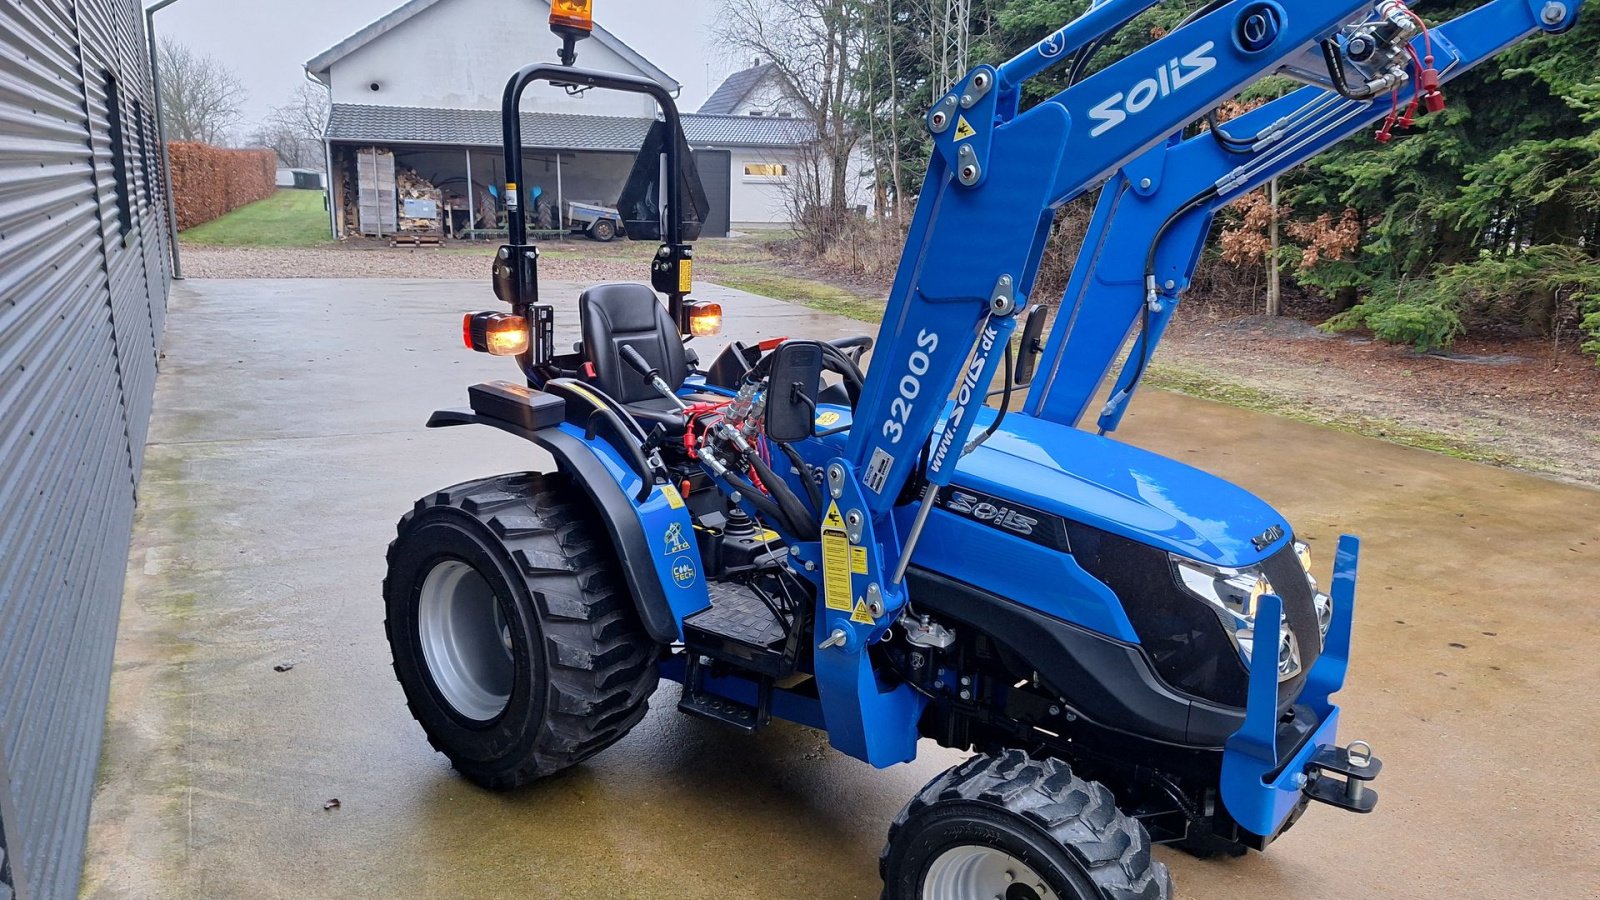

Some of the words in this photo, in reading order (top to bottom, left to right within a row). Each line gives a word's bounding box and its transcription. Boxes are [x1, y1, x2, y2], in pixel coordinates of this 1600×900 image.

[883, 328, 939, 444] 3200S
[672, 543, 689, 553] PTO
[675, 570, 694, 582] TECH
